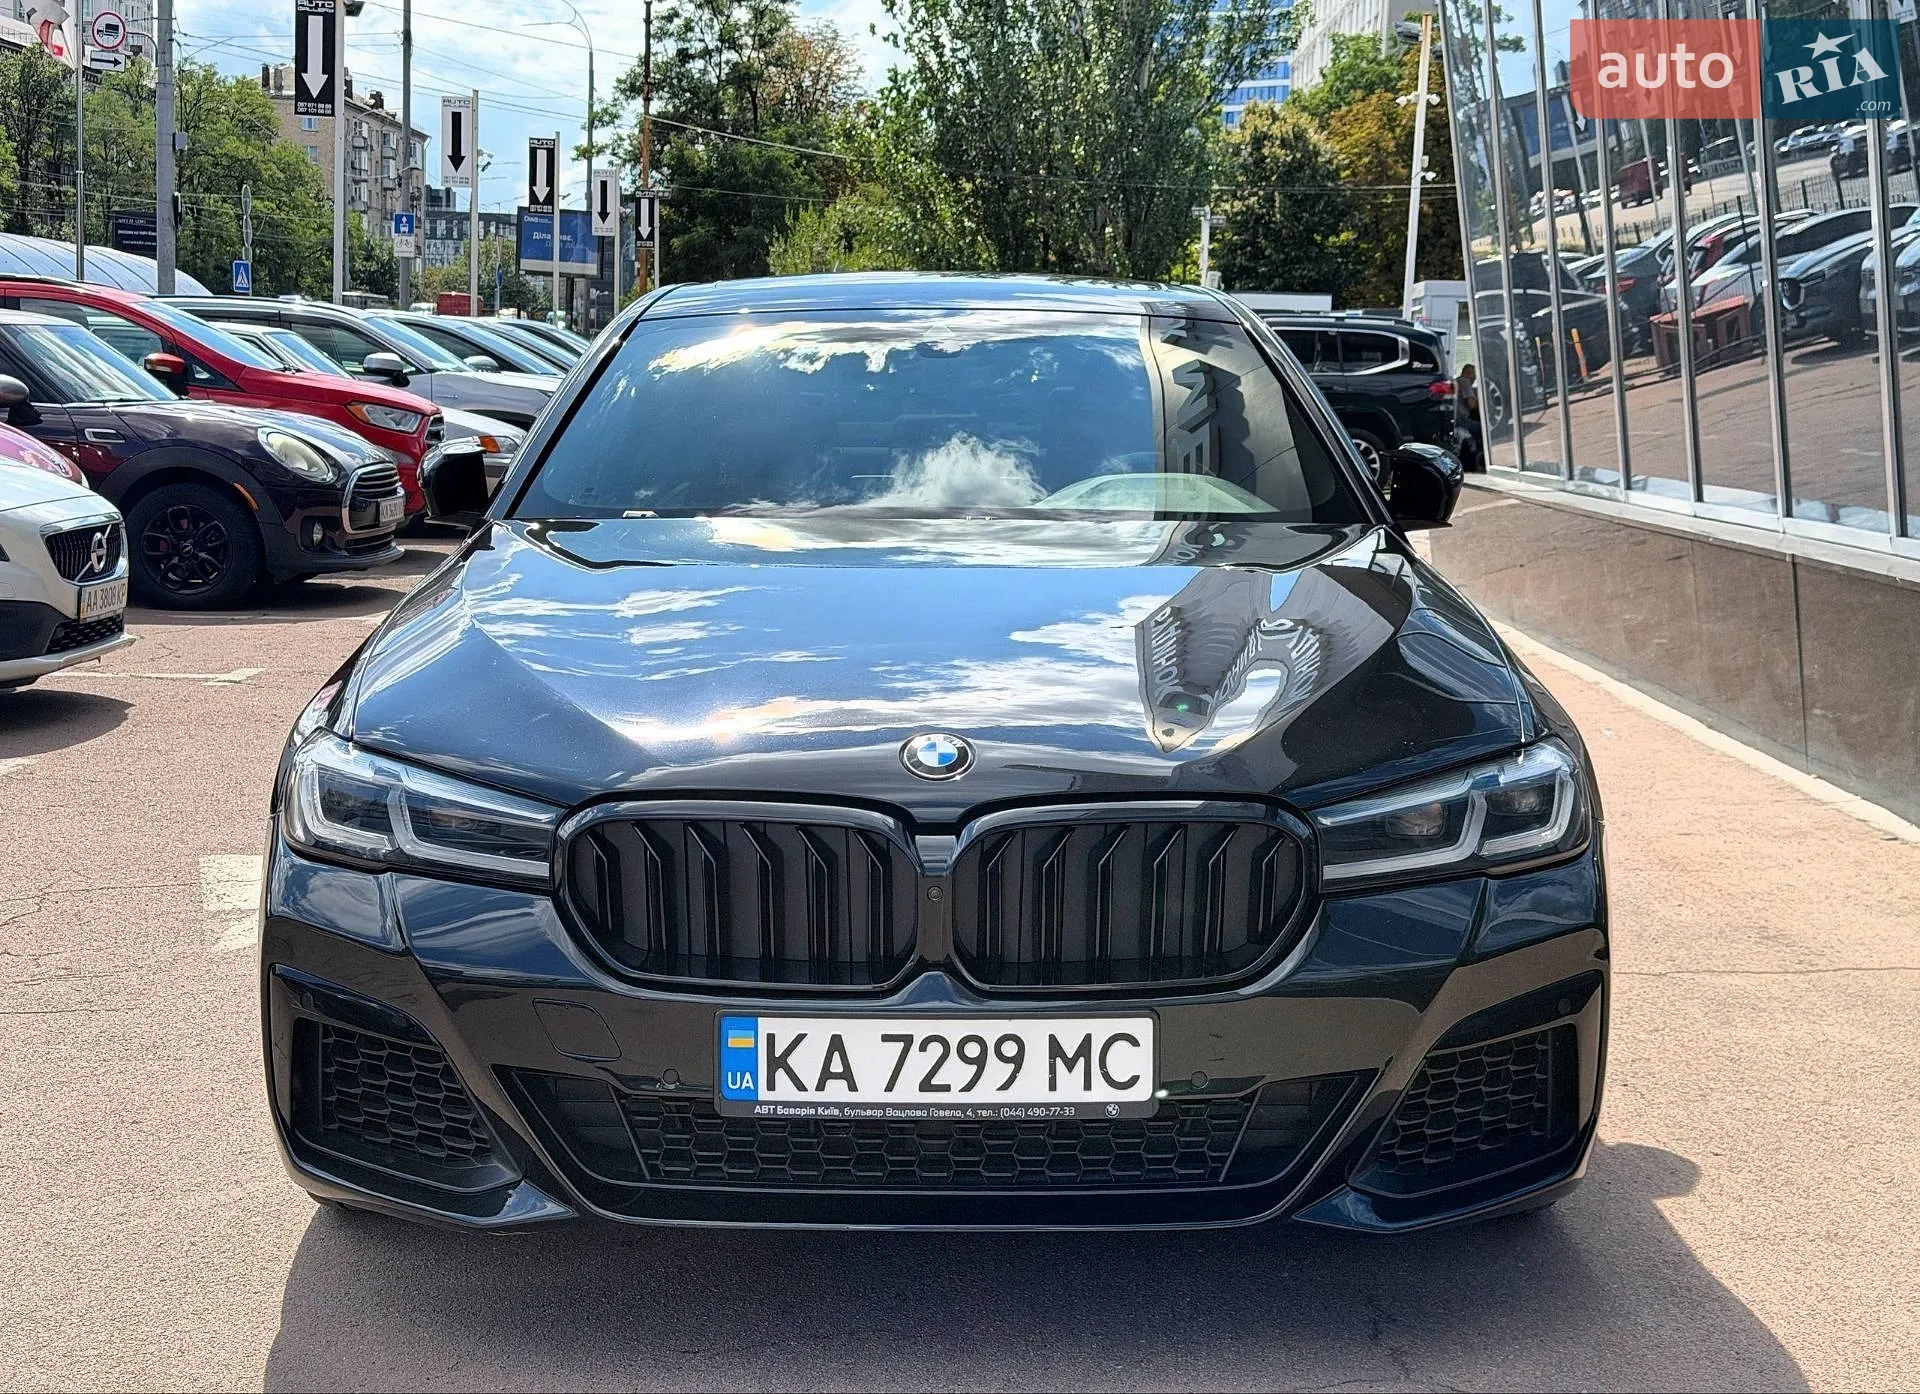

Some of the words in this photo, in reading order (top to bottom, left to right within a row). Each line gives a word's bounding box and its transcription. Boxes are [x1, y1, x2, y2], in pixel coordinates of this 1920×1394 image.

[766, 1032, 860, 1092] KA
[880, 1032, 1026, 1093] 7299
[1048, 1032, 1141, 1092] MC
[728, 1072, 754, 1090] UA
[1000, 1106, 1026, 1118] (044)
[1026, 1106, 1076, 1116] 490-77-33
